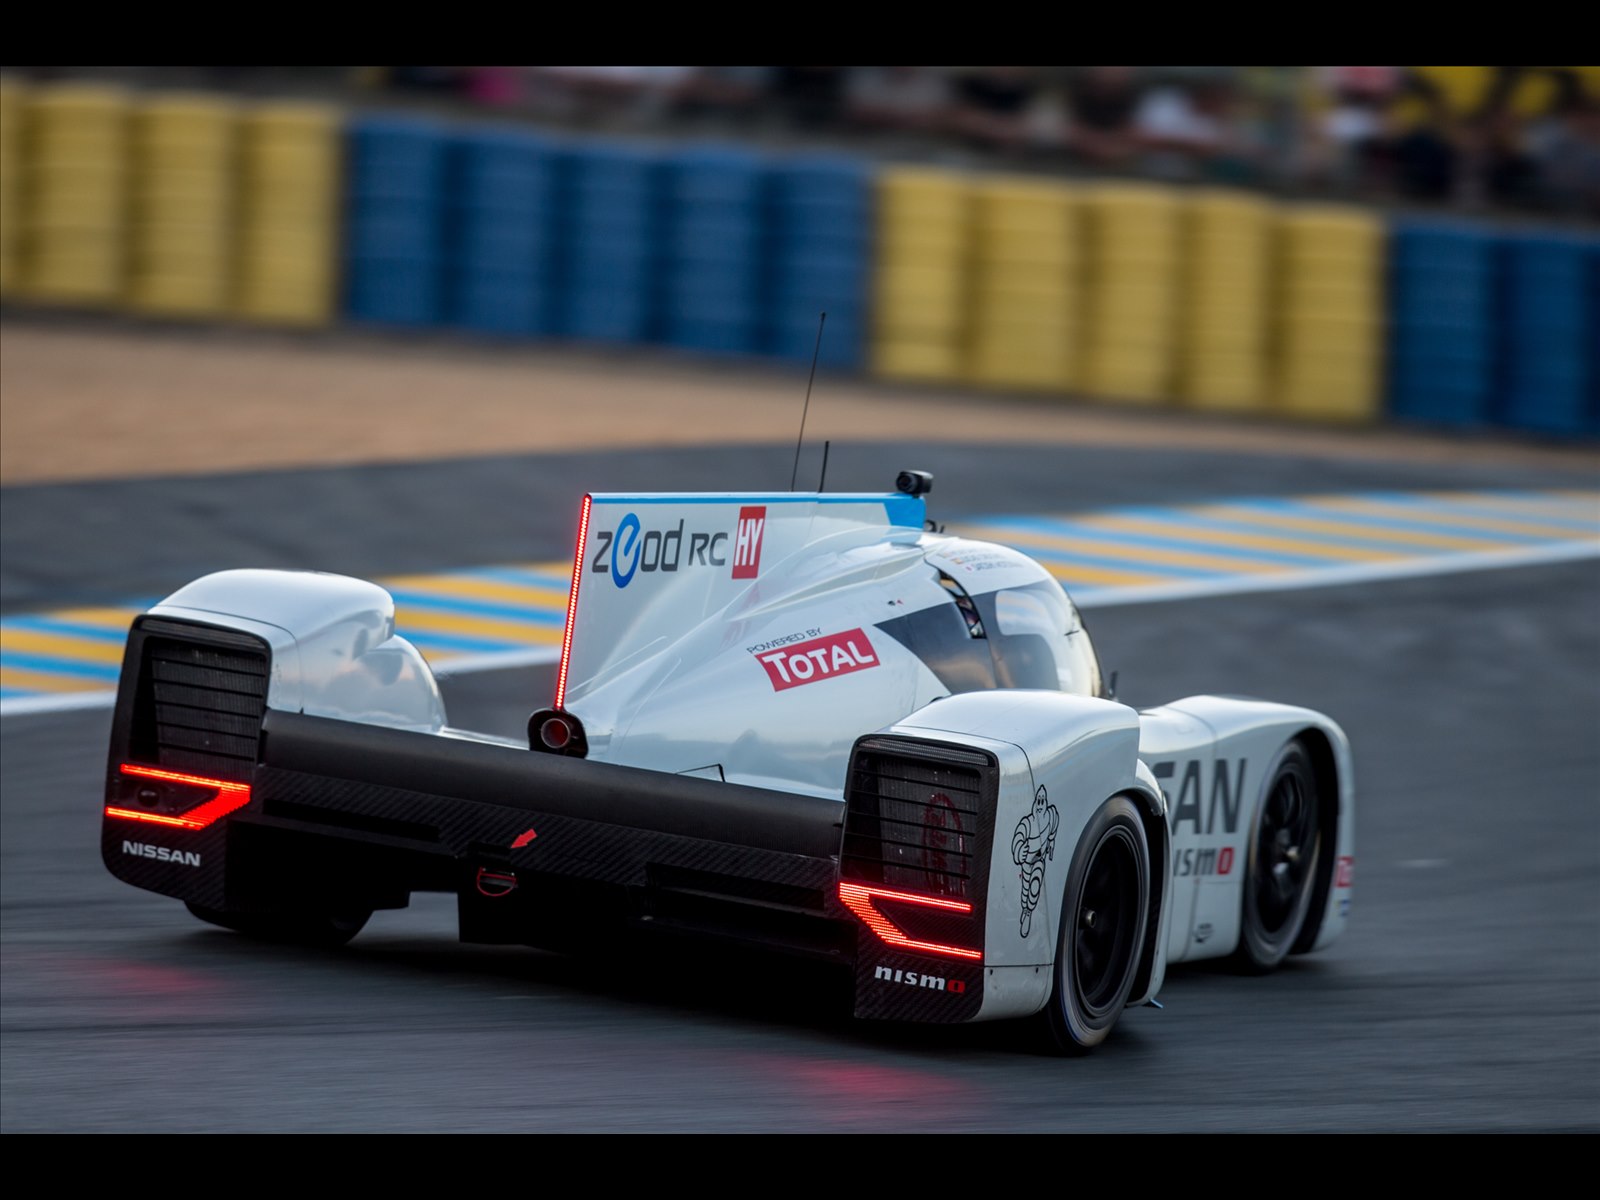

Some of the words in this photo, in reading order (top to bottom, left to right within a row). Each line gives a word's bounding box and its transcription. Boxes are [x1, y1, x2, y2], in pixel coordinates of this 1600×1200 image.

[688, 532, 728, 566] RC
[734, 517, 764, 567] HY
[746, 632, 806, 655] POWERED
[806, 627, 822, 638] BY
[122, 840, 201, 867] NISSAN
[874, 965, 966, 993] nismo
